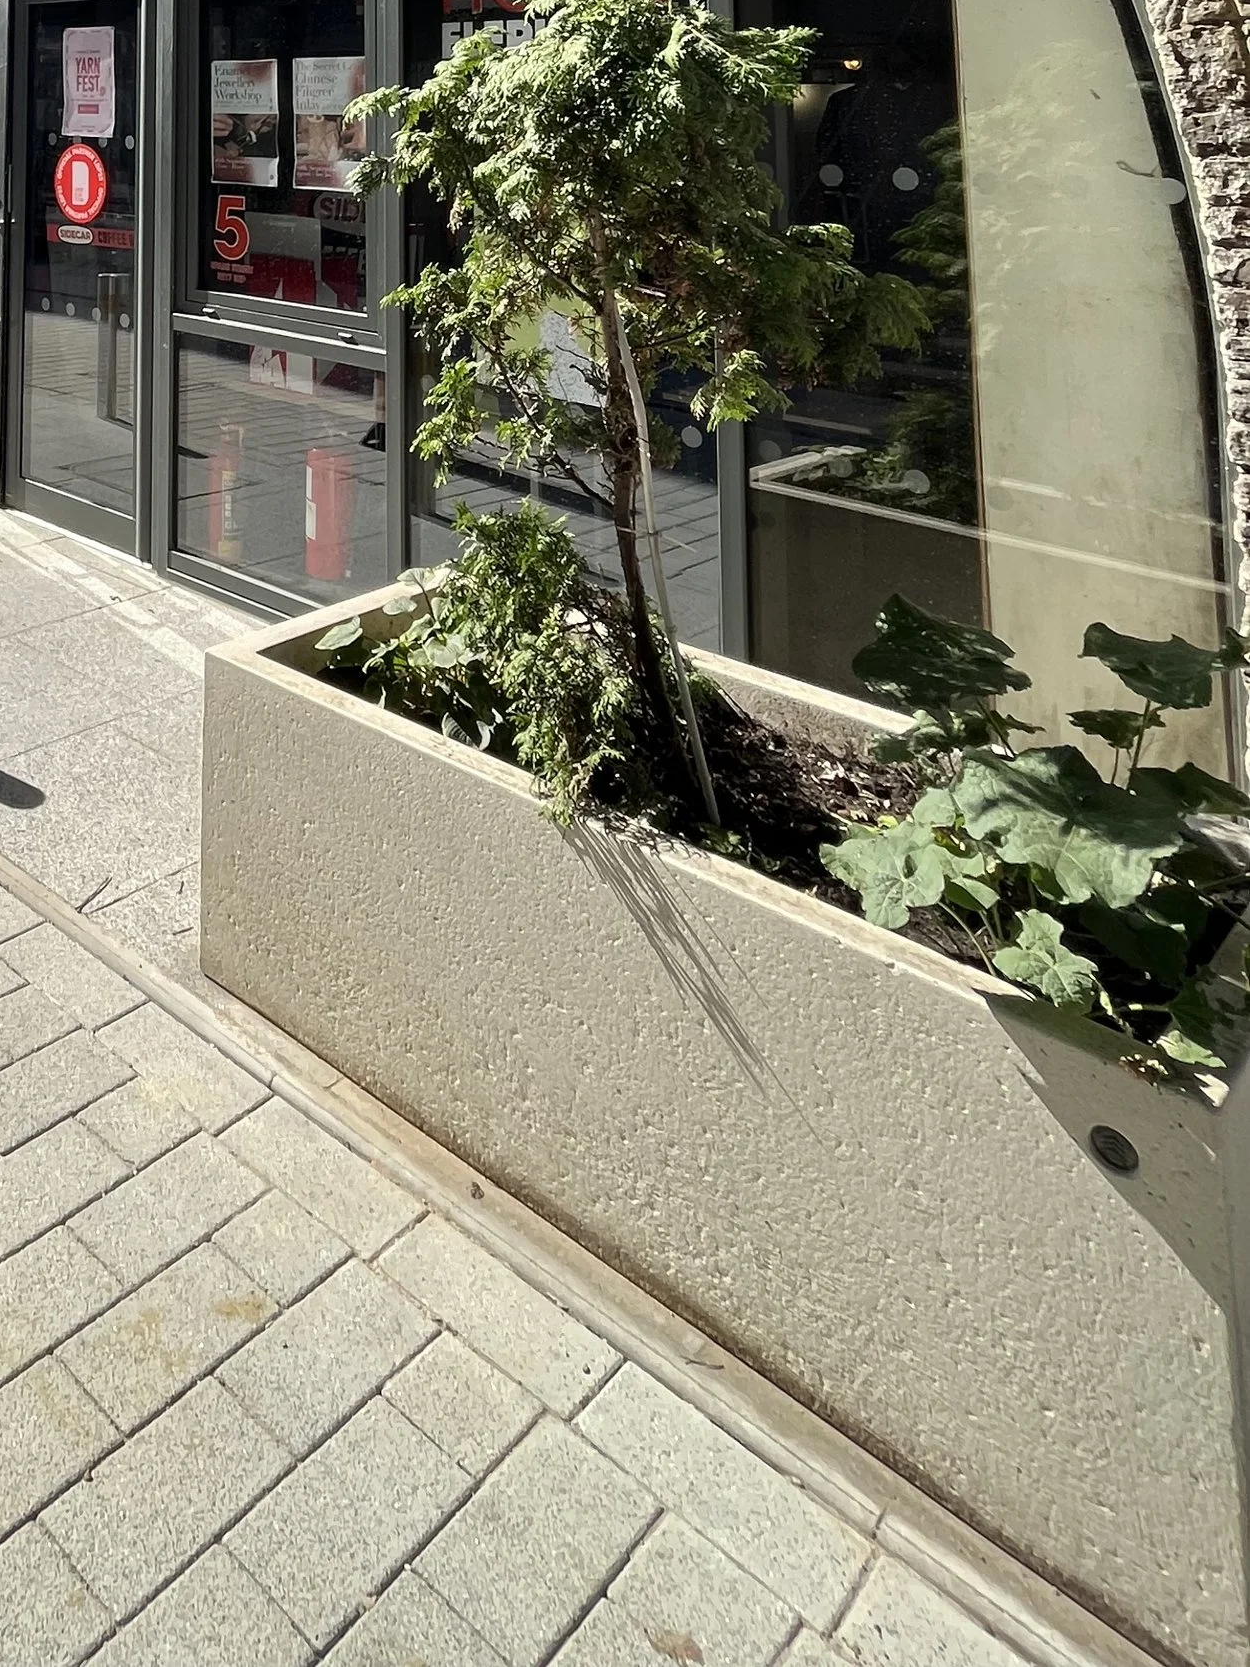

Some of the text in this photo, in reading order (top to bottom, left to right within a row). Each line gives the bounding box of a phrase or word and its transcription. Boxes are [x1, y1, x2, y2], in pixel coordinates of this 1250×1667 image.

[75, 56, 101, 74] YARN
[76, 75, 100, 92] FEST
[295, 72, 338, 84] Chinese
[214, 88, 262, 104] Workshop
[59, 229, 92, 240] SIDECAR
[214, 194, 250, 261] 5
